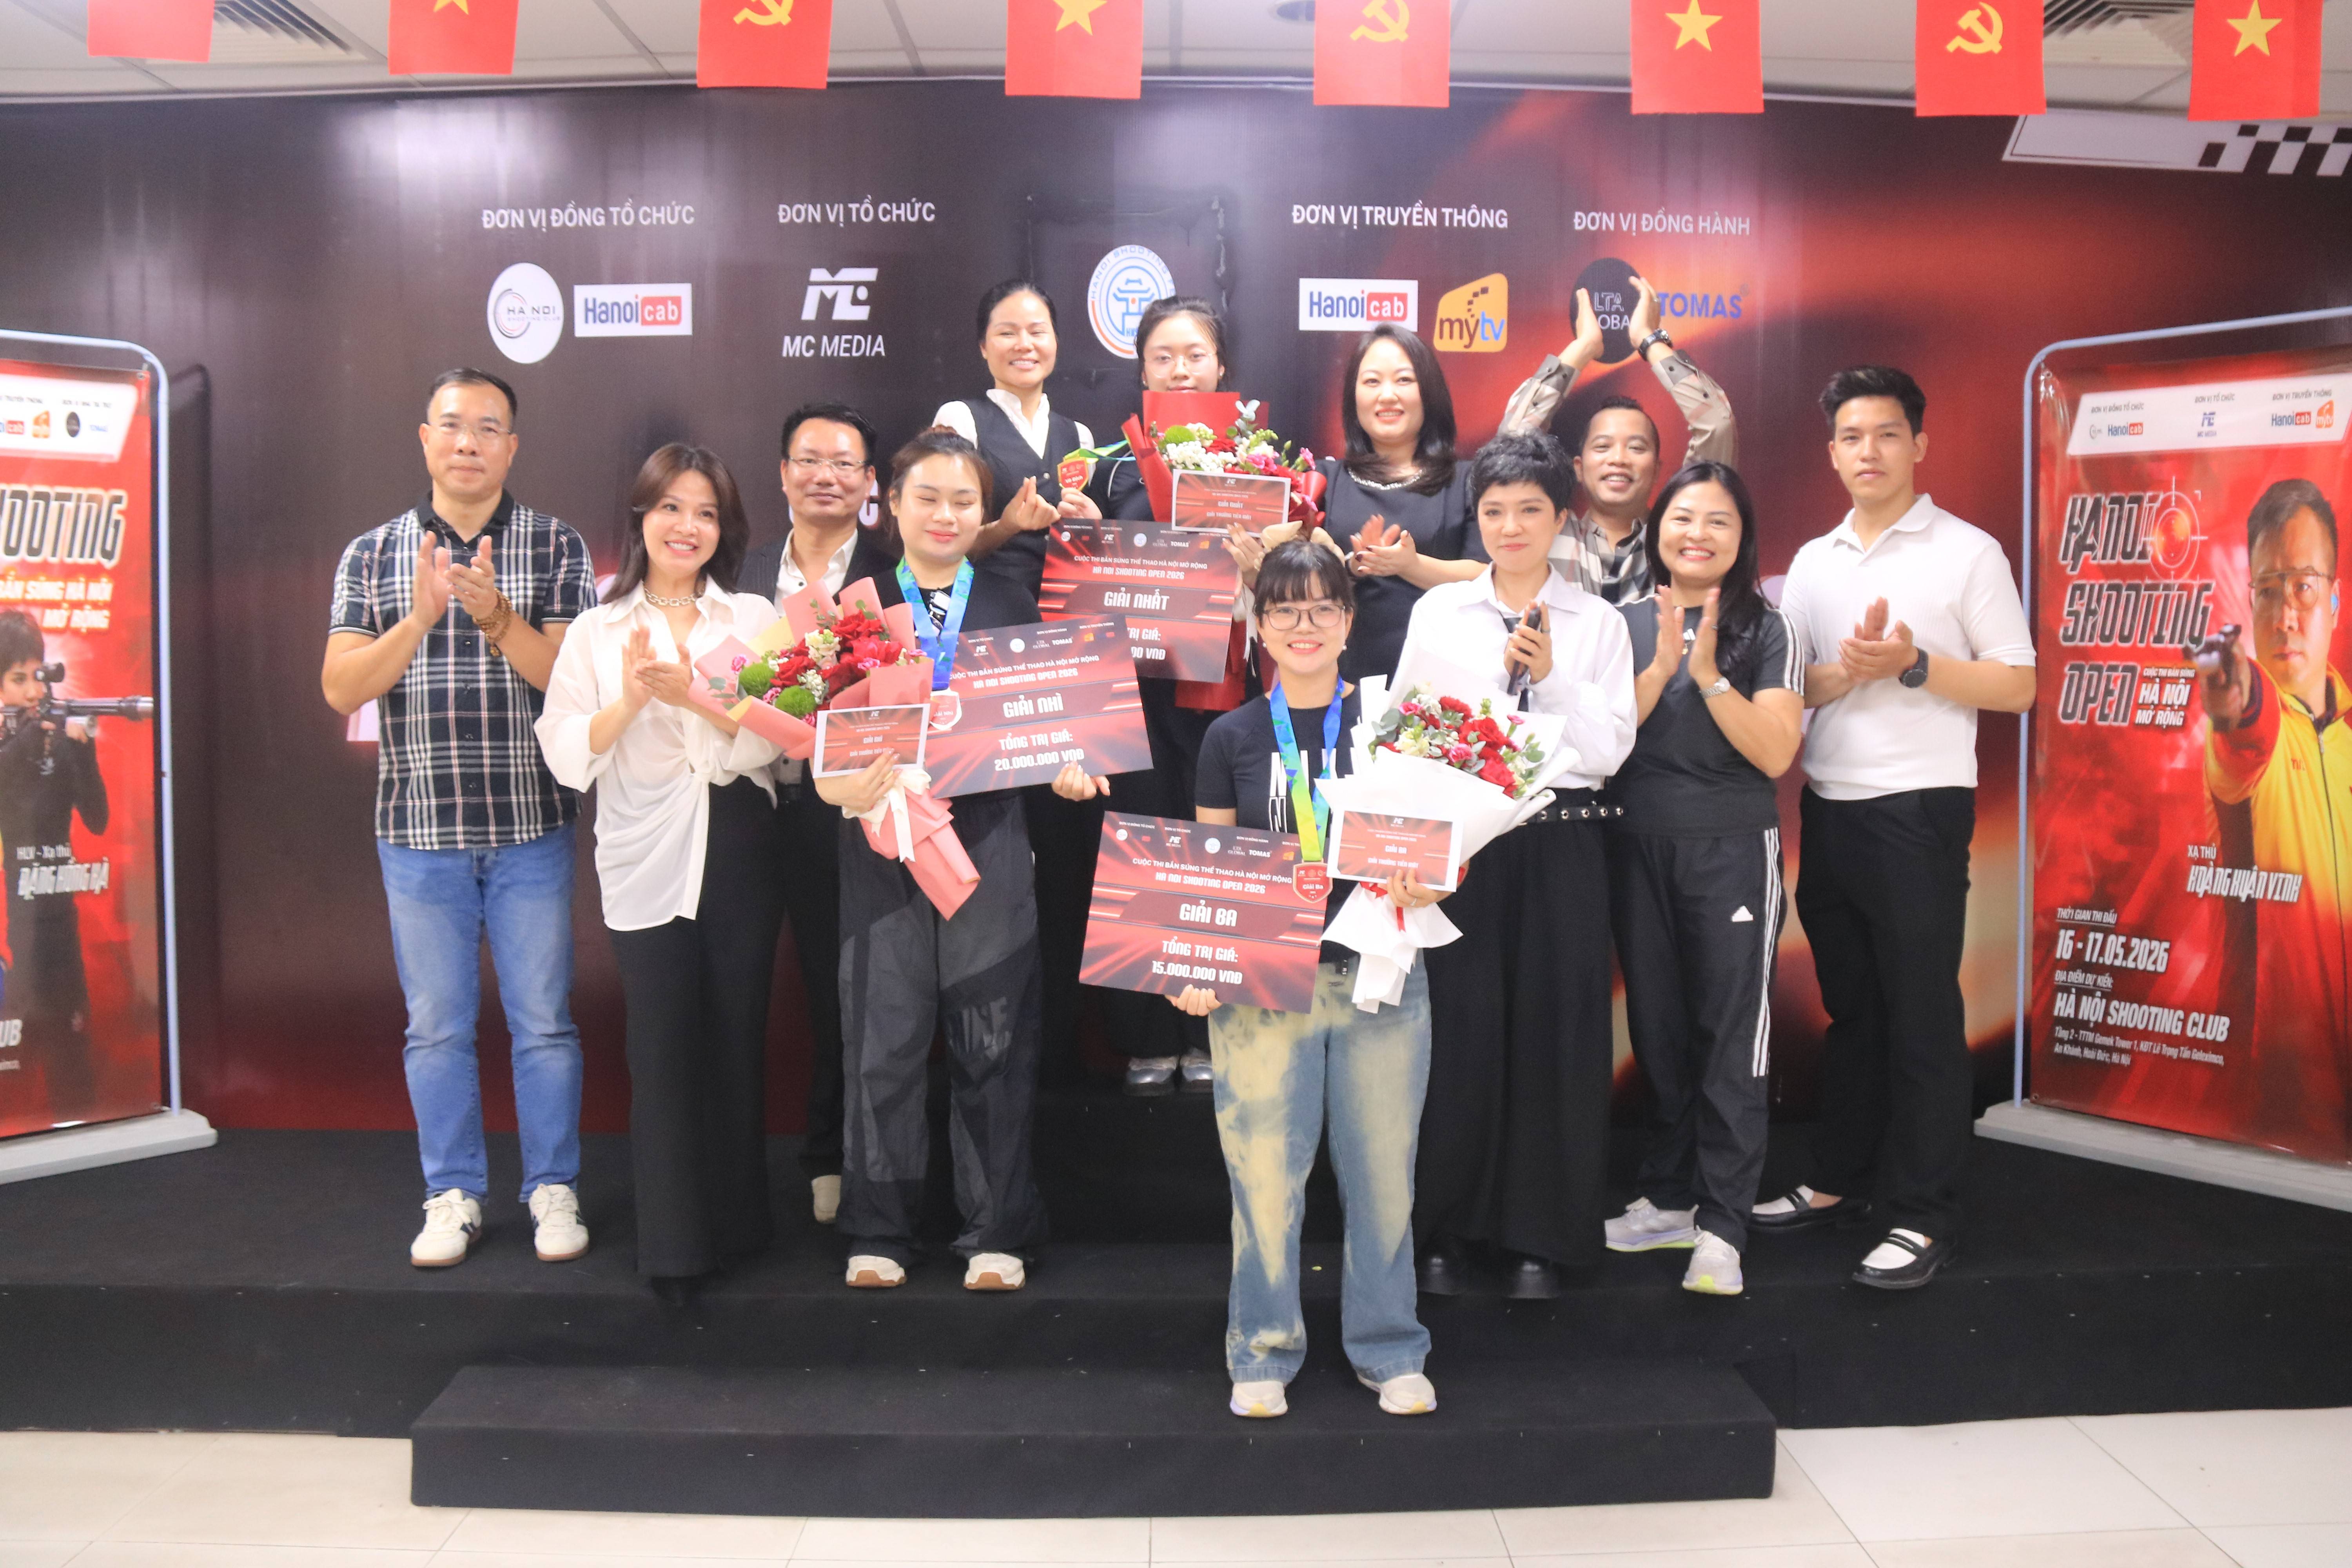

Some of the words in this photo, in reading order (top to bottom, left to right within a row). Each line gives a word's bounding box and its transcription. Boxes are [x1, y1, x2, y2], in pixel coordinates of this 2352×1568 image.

[482, 209, 524, 228] ĐƠN
[528, 208, 547, 232] VỊ
[550, 200, 606, 227] ĐỒNG
[610, 198, 635, 226] TỔ
[639, 201, 695, 225] CHỨC
[777, 203, 821, 223] ĐƠN
[825, 203, 844, 227] VỊ
[848, 194, 874, 222] TỔ
[878, 197, 936, 222] CHỨC
[1292, 204, 1335, 225] ĐƠN
[1340, 205, 1357, 229] VỊ
[1362, 200, 1437, 227] TRUYỀN
[1441, 204, 1508, 229] THÔNG
[1573, 211, 1615, 231] ĐƠN
[1619, 212, 1637, 236] VỊ
[1641, 206, 1693, 233] ĐỒNG
[1699, 211, 1750, 236] HÀNH
[507, 305, 526, 315] HA
[531, 305, 555, 315] NOI
[1593, 292, 1624, 312] LTA
[1657, 292, 1742, 319] TOMAS
[1439, 311, 1505, 349] mytv
[1598, 314, 1630, 330] OBA
[782, 335, 815, 357] MC
[820, 334, 886, 357] MEDIA
[0, 485, 127, 568] OOTING
[2059, 492, 2163, 574] HANOI
[1103, 566, 1114, 575] NOI
[1116, 567, 1147, 578] SHOOTING
[1148, 570, 1165, 578] OPEN
[1167, 571, 1185, 579] 2026
[0, 570, 25, 599] ẮN
[1104, 587, 1131, 608] GIẢI
[1134, 588, 1170, 610] NHẤT
[2059, 580, 2215, 652] SHOOTING
[1142, 627, 1161, 641] GIÁ:
[979, 668, 993, 676] BẮN
[1013, 662, 1026, 671] THỂ
[1081, 655, 1100, 663] RỘNG
[1146, 647, 1167, 661] VNĐ
[973, 680, 984, 689] HA
[985, 679, 999, 687] NOI
[1000, 673, 1036, 686] SHOOTING
[1037, 669, 1057, 681] OPEN
[1058, 668, 1078, 678] 2026
[1002, 695, 1034, 718] GIẢI
[1037, 692, 1064, 713] NHÌ
[2059, 662, 2139, 725] OPEN
[2139, 678, 2160, 704] HÀ
[2162, 679, 2190, 709] NỘI
[2135, 705, 2155, 724] MỞ
[2156, 706, 2185, 728] RỘNG
[998, 732, 1029, 751] TỔNG
[1030, 733, 1049, 747] TRỊ
[1051, 728, 1073, 744] GIÁ:
[994, 751, 1059, 771] 20.000.000
[1061, 748, 1085, 762] VNĐ
[1249, 849, 1270, 858] TOMAS
[1385, 844, 1397, 853] GIẢI
[2188, 845, 2199, 860] XẠ
[2201, 843, 2216, 859] THỦ
[1132, 858, 1152, 866] CUỘC
[1165, 860, 1180, 869] BẮN
[1235, 869, 1245, 878] HÀ
[1272, 875, 1292, 884] RỘNG
[1156, 872, 1167, 881] HA
[1168, 873, 1181, 883] NOI
[1183, 875, 1221, 888] SHOOTING
[1222, 880, 1243, 891] OPEN
[1244, 883, 1266, 894] 2026
[1179, 900, 1212, 924] GIẢI
[1215, 908, 1238, 927] BA
[2057, 905, 2074, 919] THỜI
[2074, 909, 2092, 920] GIAN
[2092, 911, 2103, 922] THI
[2103, 909, 2117, 924] ĐẤU
[1162, 936, 1192, 956] TỔNG
[1195, 944, 1213, 961] TRỊ
[1215, 947, 1239, 962] GIÁ:
[2055, 929, 2075, 960] 16
[2085, 931, 2170, 973] 17.05.2026
[1152, 960, 1216, 981] 15.000.000
[1219, 969, 1243, 985] VNĐ
[2055, 969, 2067, 982] ĐỊA
[2068, 969, 2085, 984] ĐIỂM
[2085, 973, 2097, 987] DỰ
[2054, 988, 2076, 1018] HÀ
[2078, 991, 2106, 1027] NỘI
[2107, 1000, 2184, 1035] SHOOTING
[2186, 1012, 2230, 1042] CLUB
[2069, 1029, 2074, 1039] 2
[2079, 1030, 2094, 1042] TTTM
